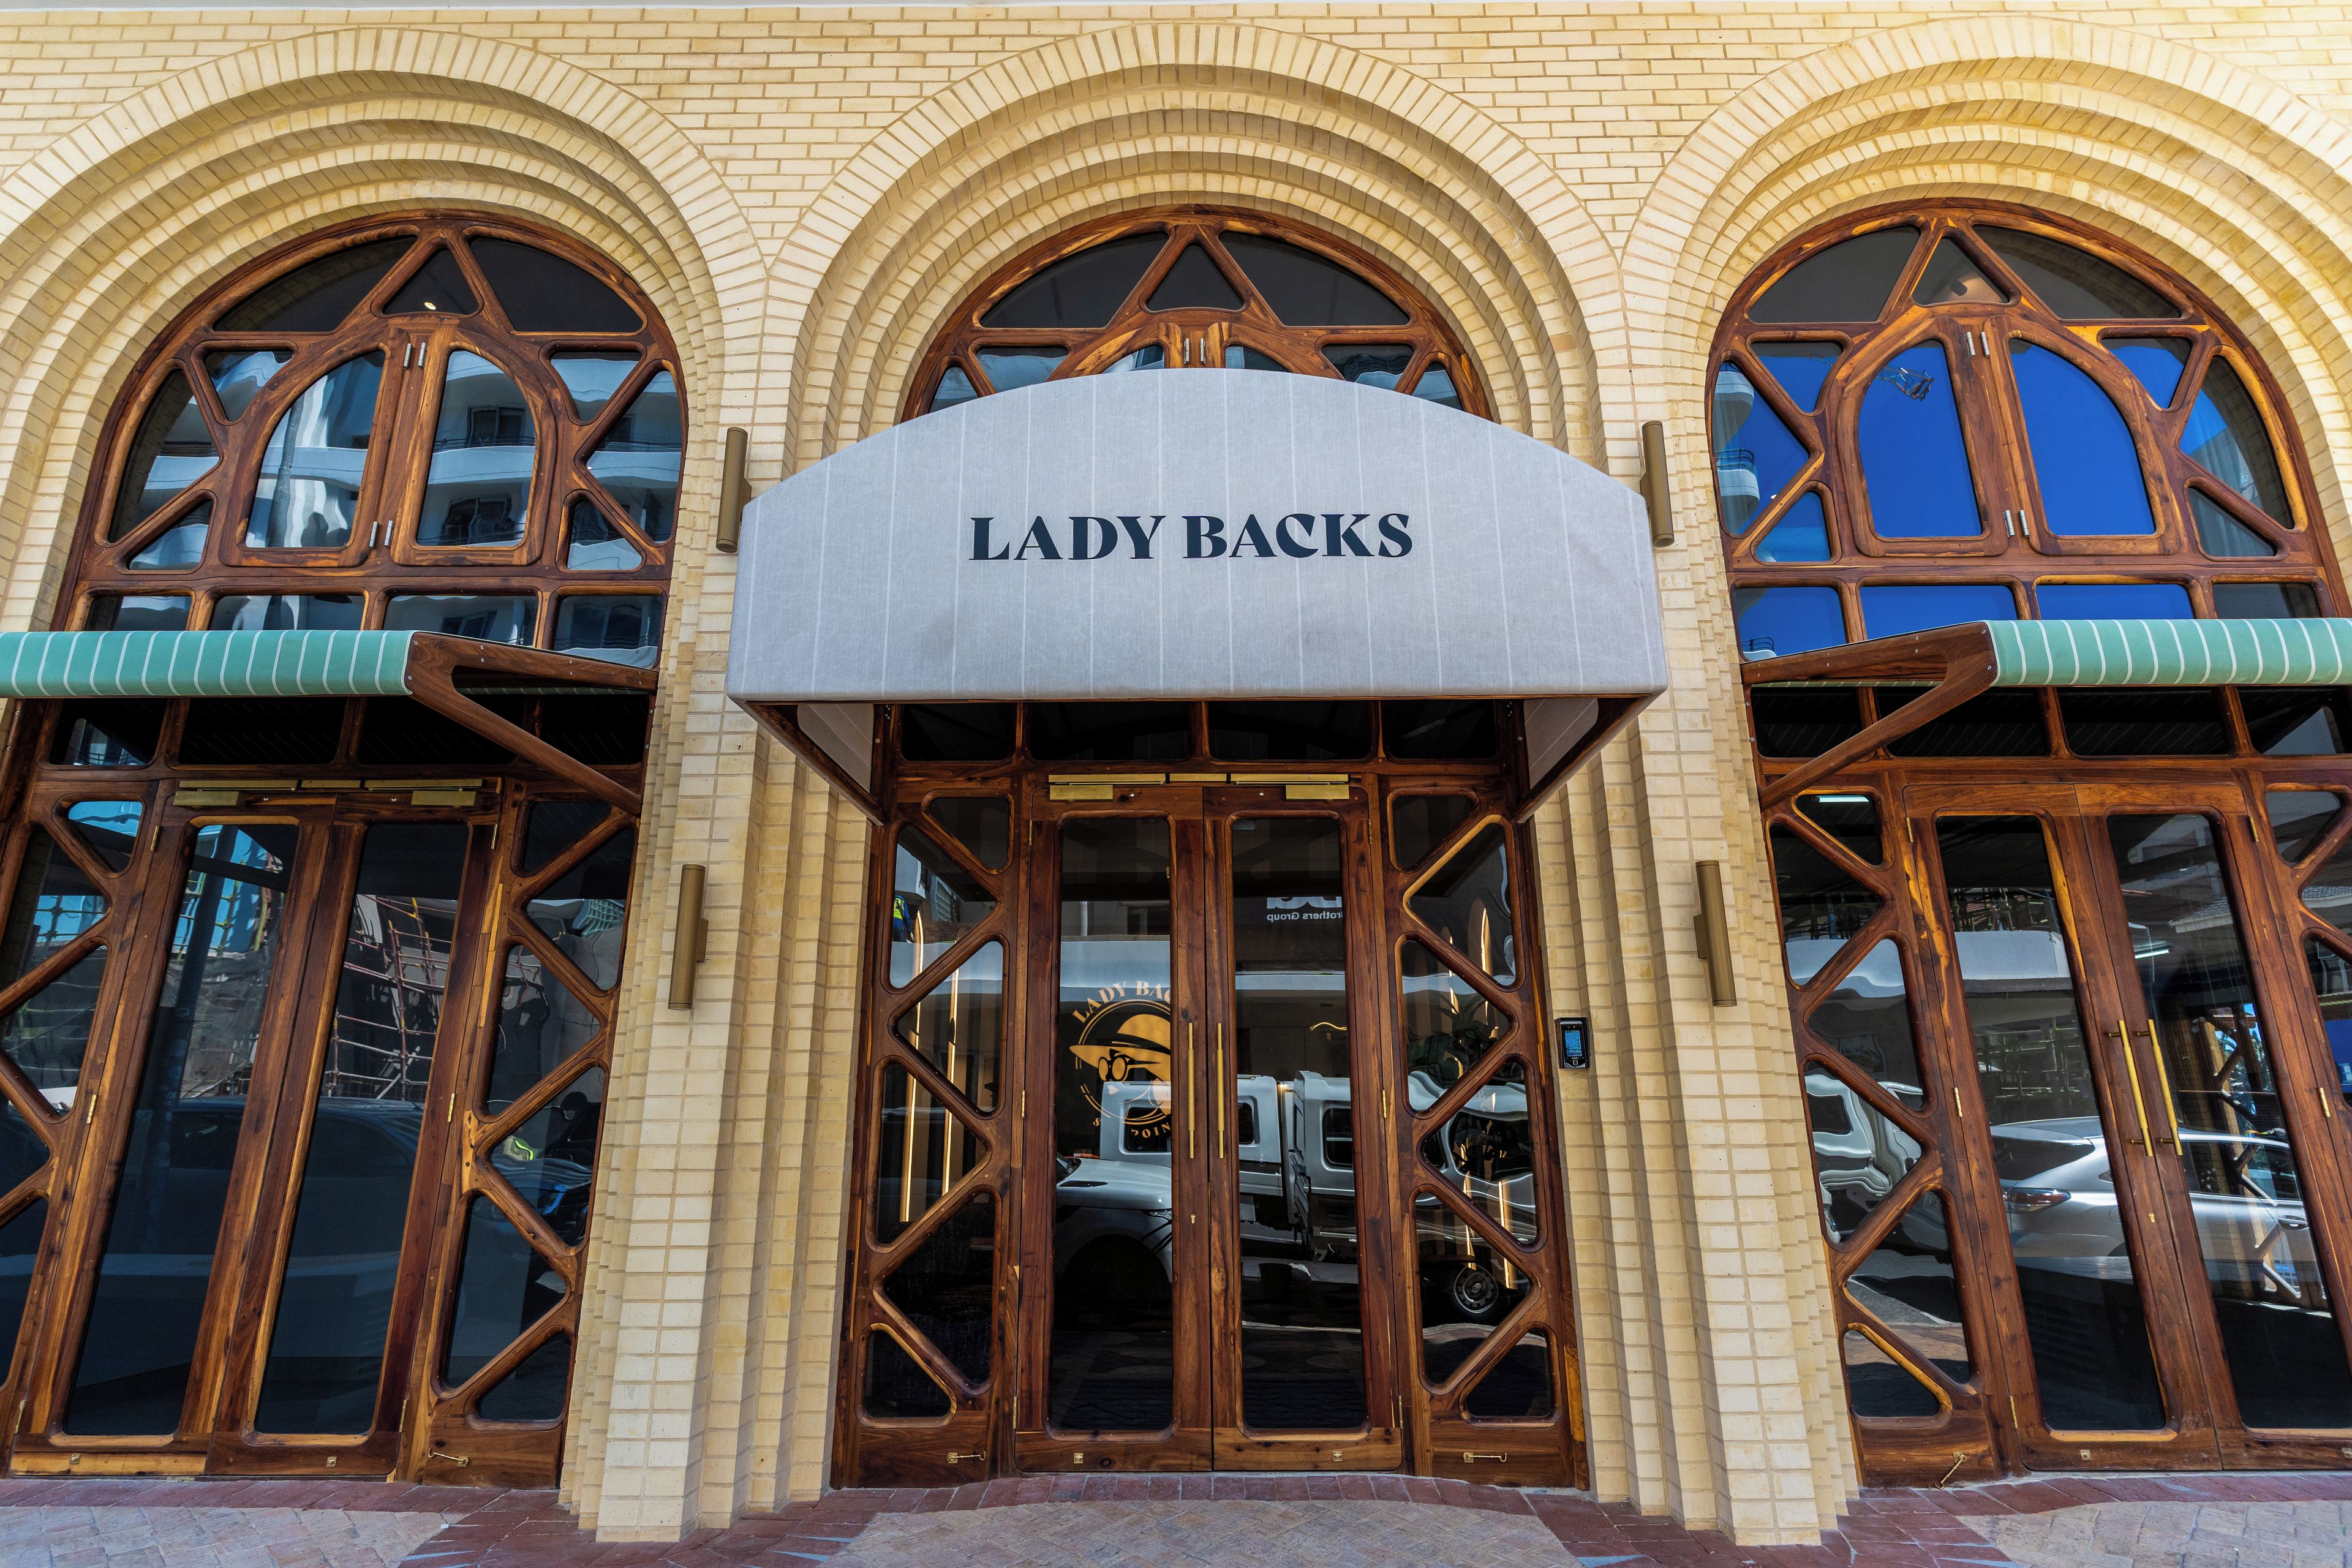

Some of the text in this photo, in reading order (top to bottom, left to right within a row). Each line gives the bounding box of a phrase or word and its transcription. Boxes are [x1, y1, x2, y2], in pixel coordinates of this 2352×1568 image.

[968, 513, 1413, 561] LADY BACKS
[1072, 981, 1127, 1024] LADY
